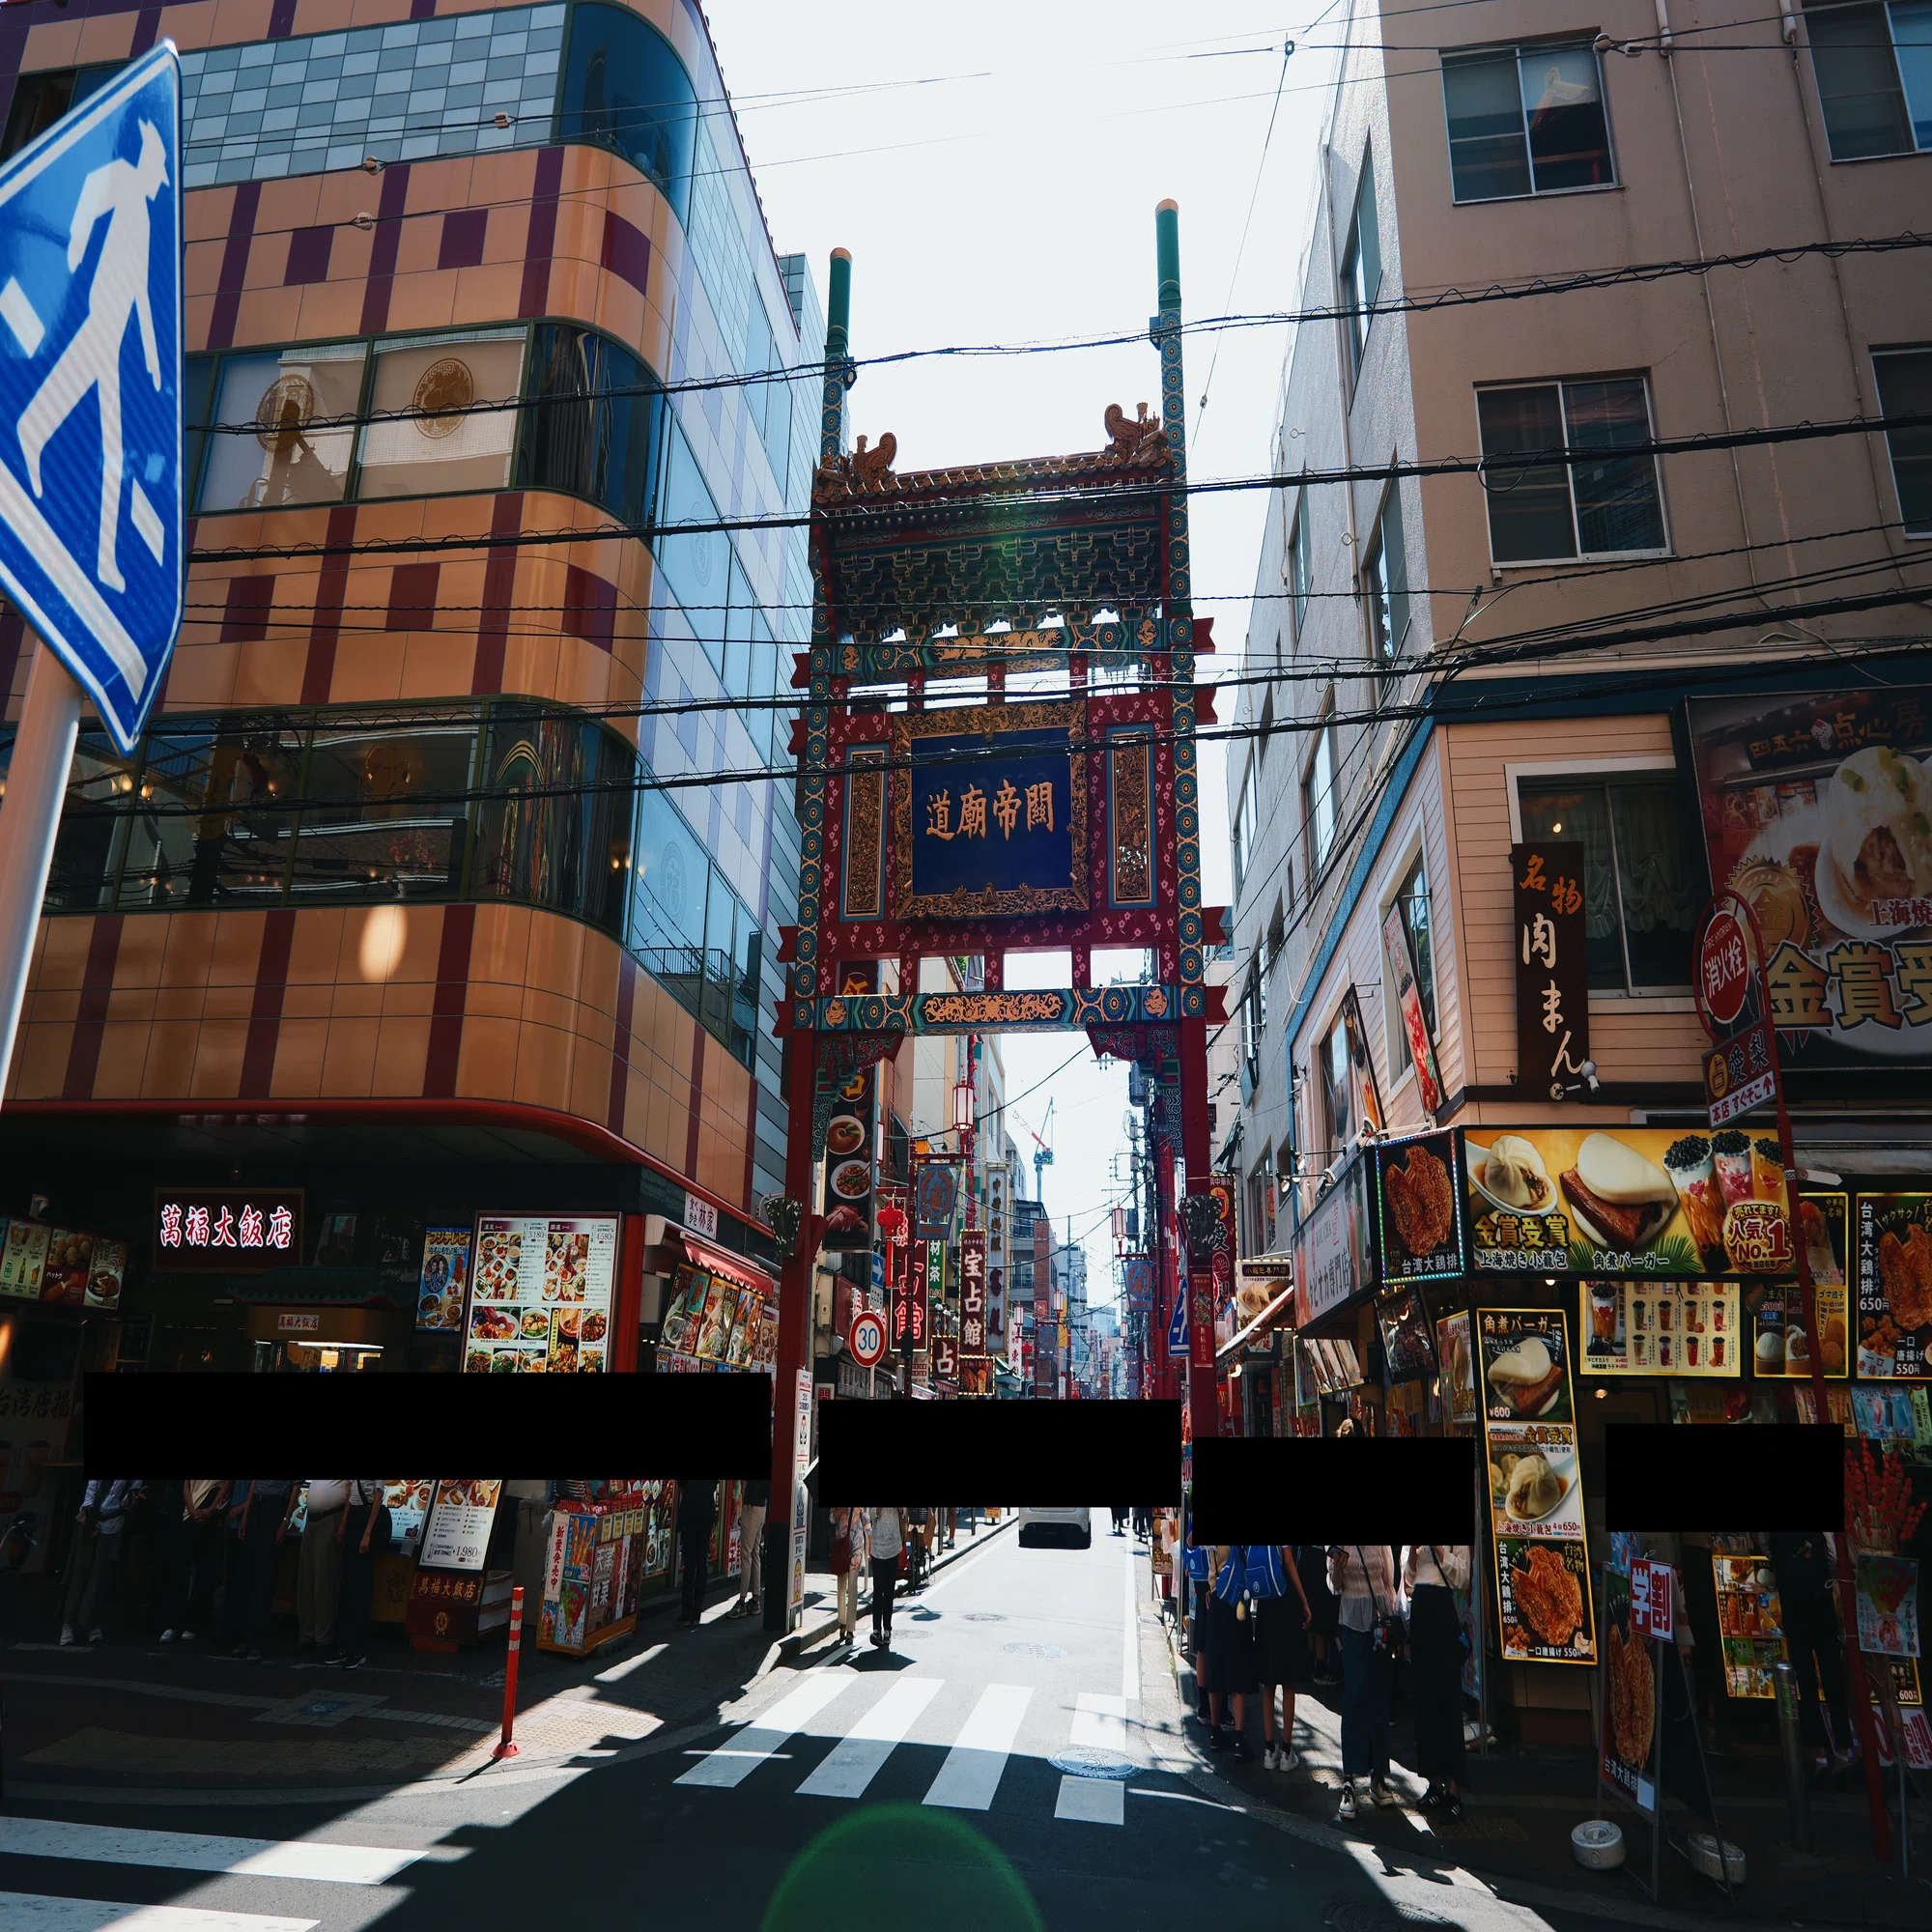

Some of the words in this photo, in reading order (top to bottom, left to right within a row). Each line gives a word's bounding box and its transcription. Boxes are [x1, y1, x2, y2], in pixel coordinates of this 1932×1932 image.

[1748, 729, 1811, 758] 四五六
[1833, 697, 1926, 749] 点心房
[1520, 854, 1582, 915] 名物
[1705, 935, 1715, 952] FIRE
[1715, 918, 1735, 944] HYDRANT
[1704, 935, 1746, 999] 消火栓
[1522, 913, 1585, 1077] 肉まん
[1712, 1058, 1725, 1094] 占
[1728, 1030, 1769, 1088] 愛梨
[1712, 1100, 1730, 1123] 本店
[1732, 1081, 1763, 1109] すぐそこ
[159, 1204, 293, 1250] 萬福大飯店
[1474, 1213, 1570, 1248] 金賞受賞
[1728, 1218, 1763, 1247] 人気
[1881, 1208, 1913, 1225] サクサク
[429, 1232, 467, 1245] フジテレビ
[1861, 1202, 1874, 1295] 台湾大鶏排
[1593, 1250, 1670, 1270] 角煮バーガー
[964, 1248, 983, 1347] 宝占館
[1819, 1289, 1845, 1299] ゴマ団子
[278, 1315, 319, 1329] 萬福大飯店
[1484, 1314, 1562, 1334] 角煮バーガー
[858, 1327, 878, 1350] 30
[936, 1341, 954, 1374] 占
[1896, 1350, 1924, 1361] 唐揚げ
[1489, 1406, 1511, 1418] ¥600
[1524, 1425, 1573, 1445] 金賞受賞
[419, 1577, 477, 1601] 萬福大飯店
[591, 1578, 611, 1609] 甘栗
[1632, 1567, 1670, 1633] 学割
